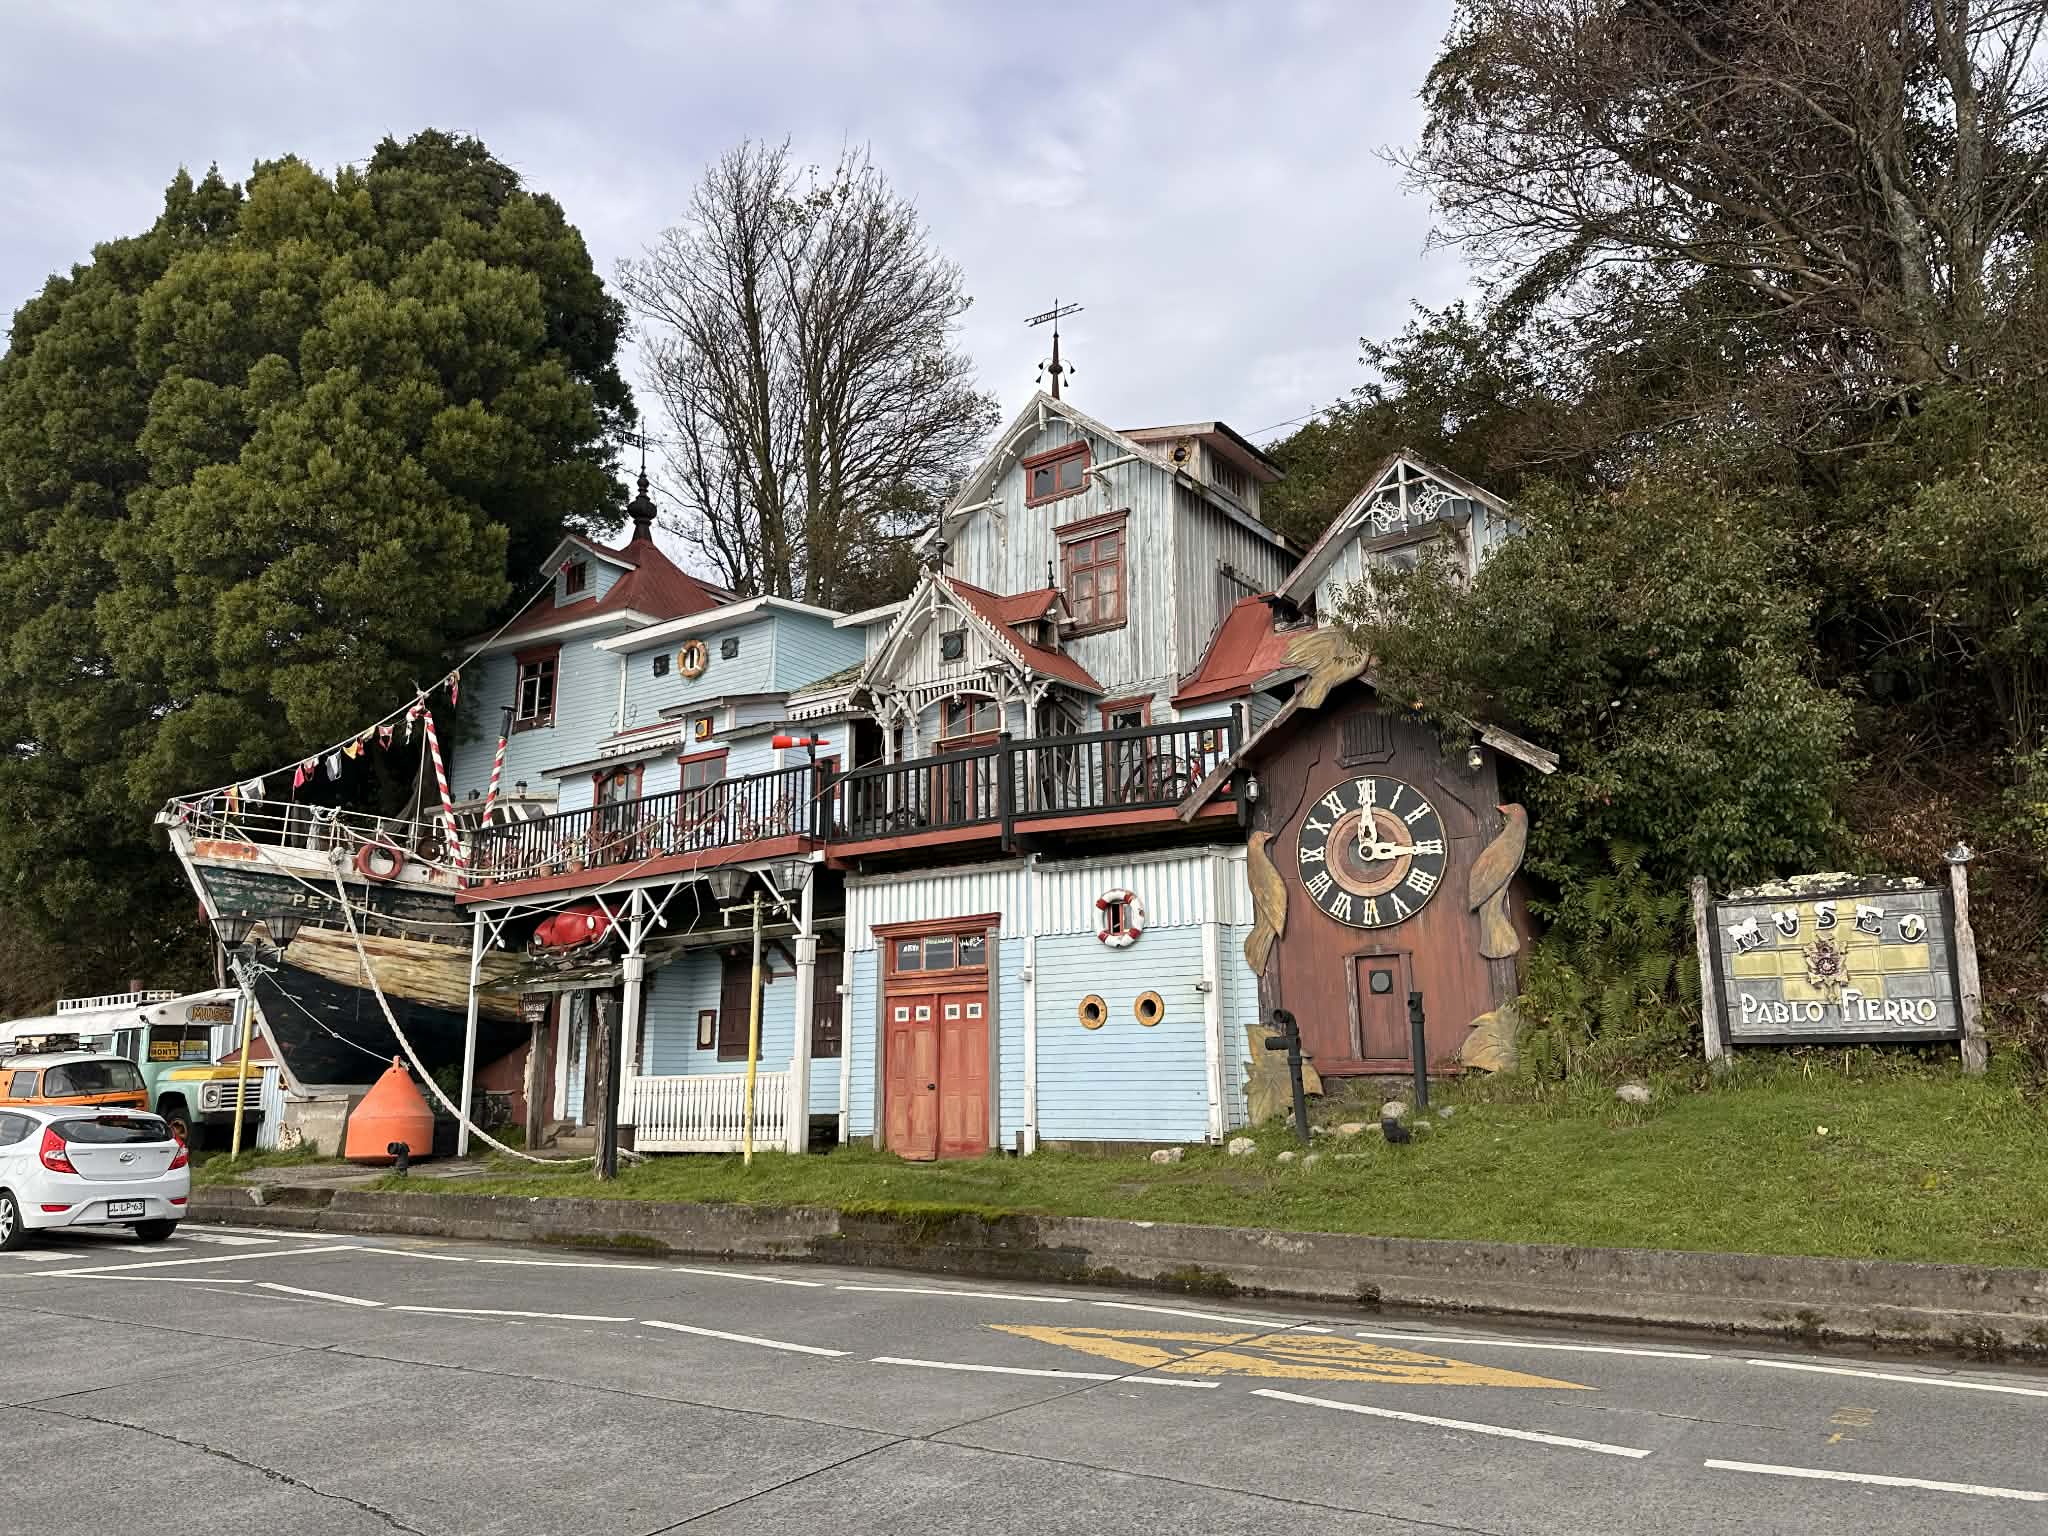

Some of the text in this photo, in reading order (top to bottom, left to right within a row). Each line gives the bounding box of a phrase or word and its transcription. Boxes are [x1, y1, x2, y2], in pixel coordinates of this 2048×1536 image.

[1322, 790, 1347, 819] XI
[1389, 784, 1404, 810] I
[1305, 816, 1331, 836] X
[1404, 801, 1431, 825] II
[1299, 846, 1325, 864] IX
[1305, 870, 1333, 902] VIII
[292, 893, 379, 914] PETEL
[1329, 891, 1352, 922] VII
[1363, 897, 1382, 925] VI
[1390, 892, 1412, 919] V
[1727, 900, 1928, 955] MUSEO
[1741, 988, 1938, 1027] PABLO FIERRO
